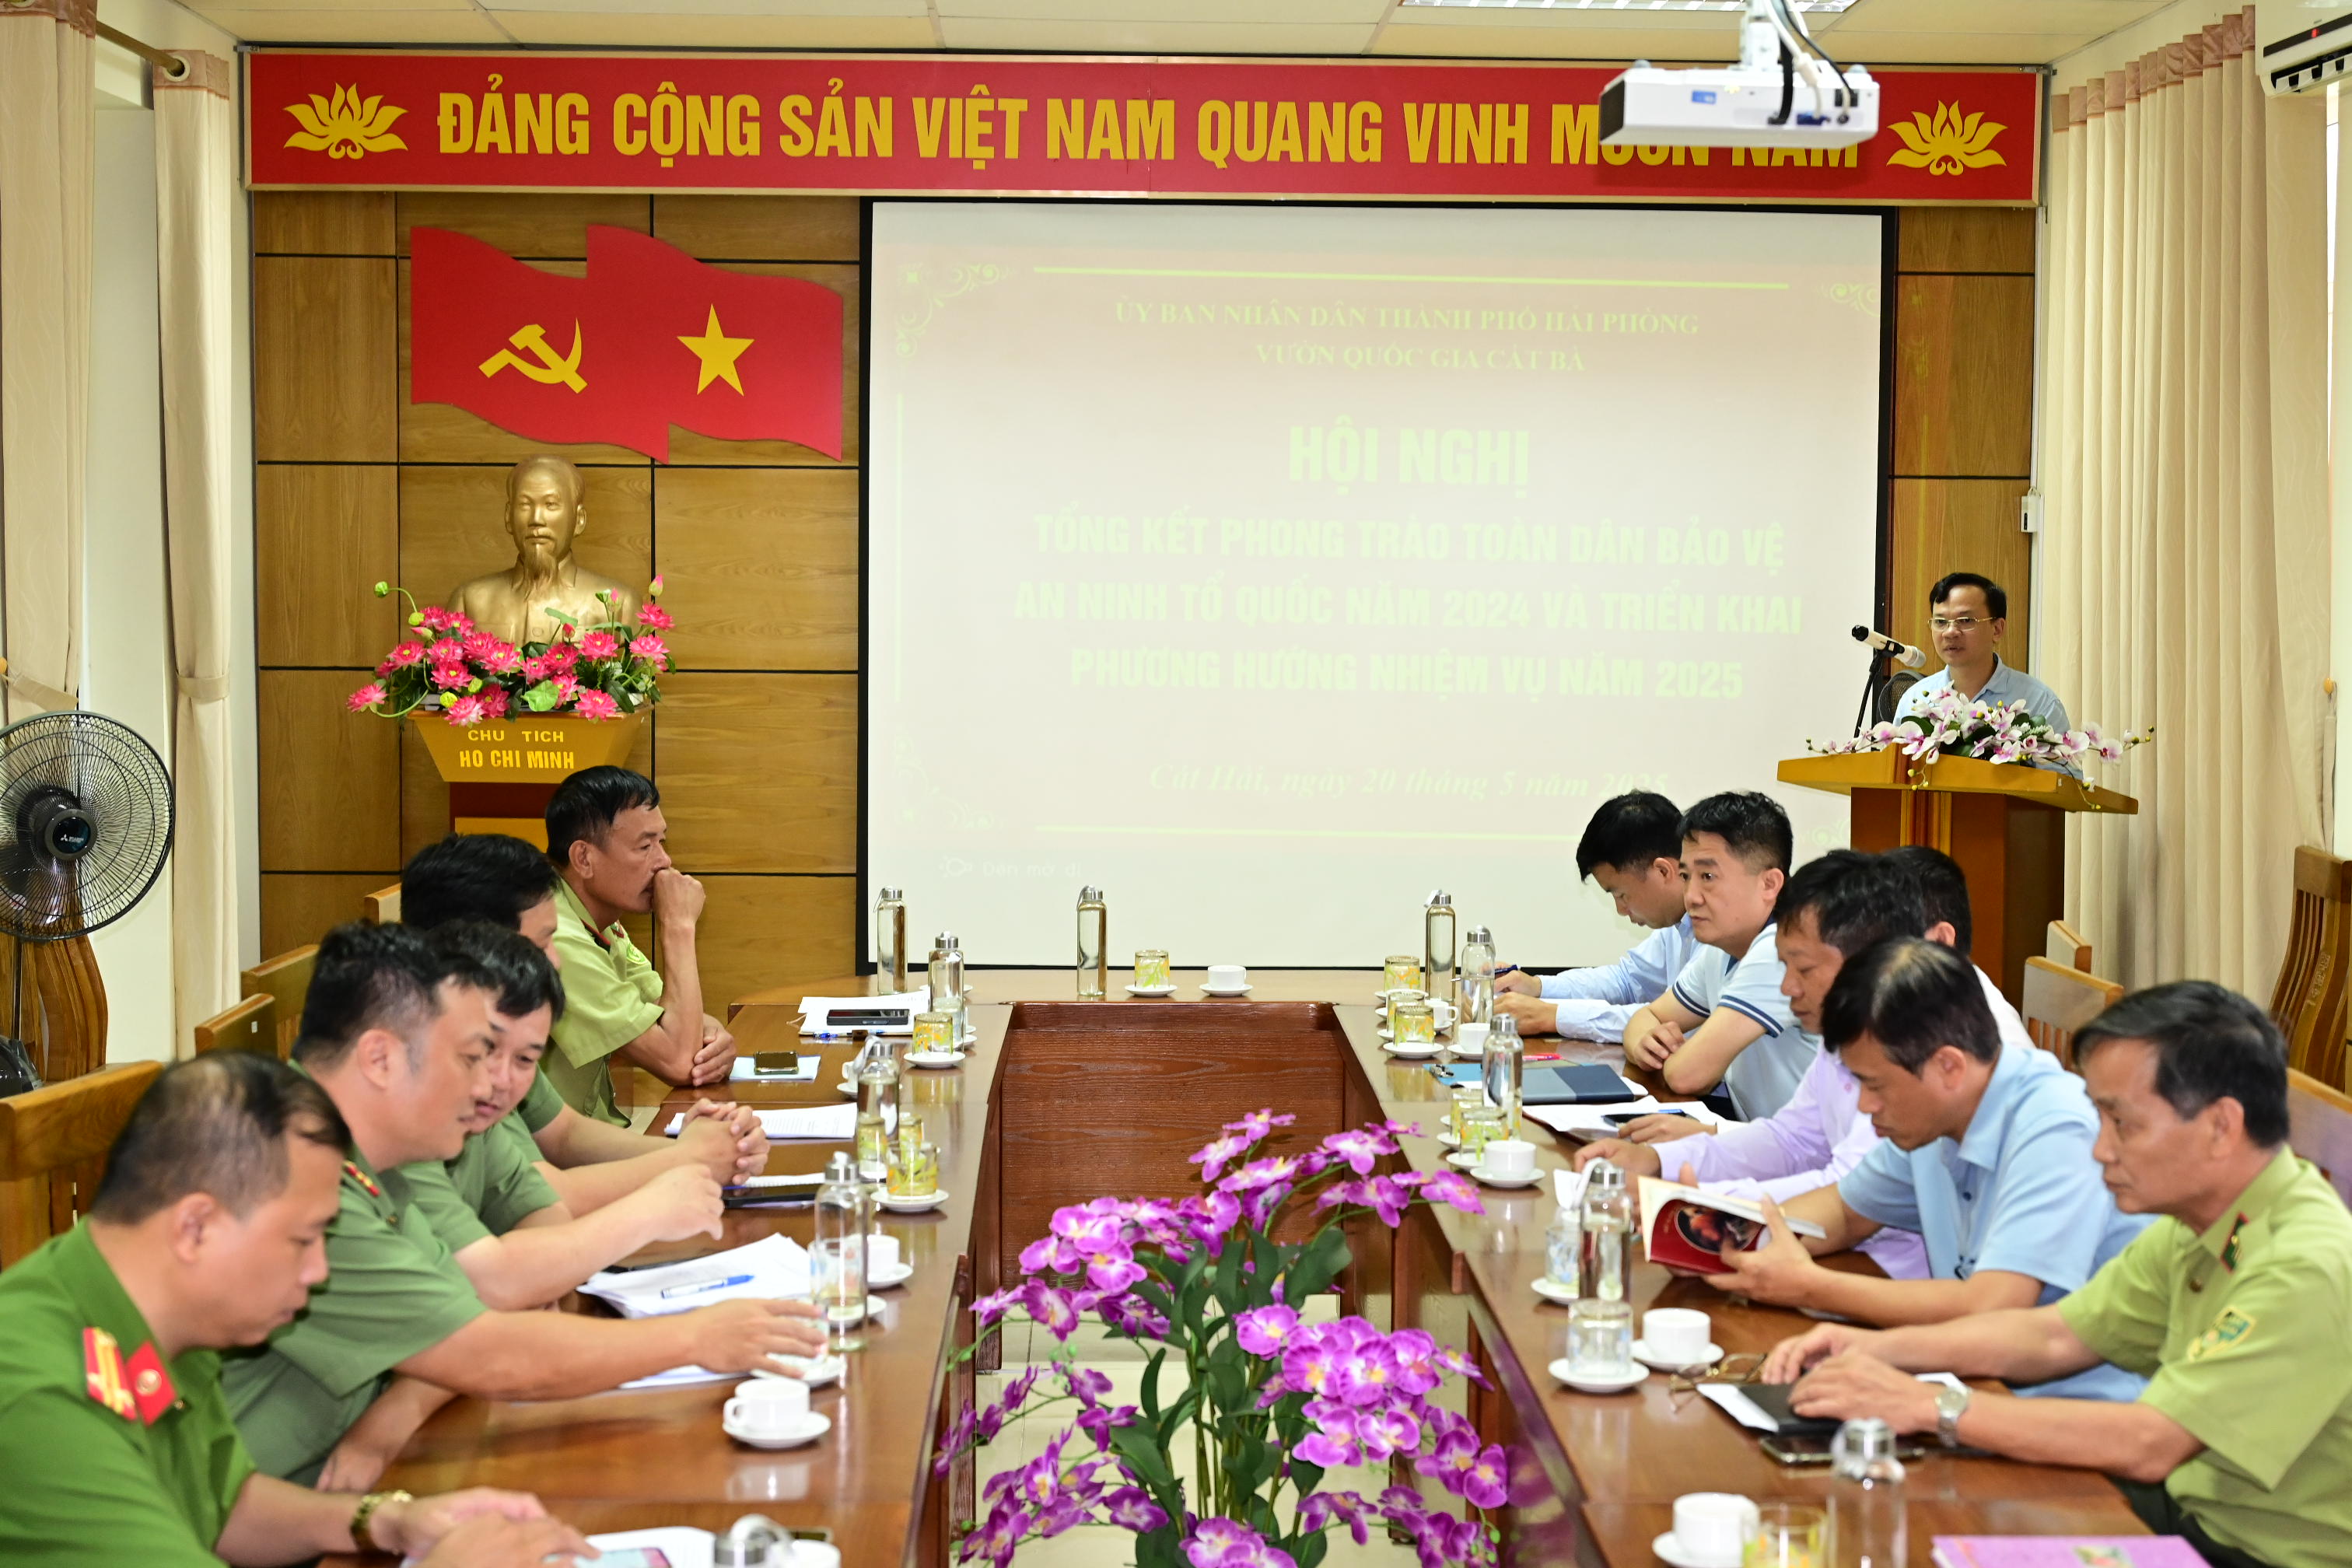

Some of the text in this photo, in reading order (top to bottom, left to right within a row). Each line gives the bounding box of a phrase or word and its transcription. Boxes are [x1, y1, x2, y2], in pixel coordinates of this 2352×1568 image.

[438, 73, 590, 155] ĐẢNG
[614, 81, 761, 168] CỘNG
[780, 79, 893, 158] SẢN
[913, 84, 1028, 170] VIỆT
[1048, 99, 1175, 160] NAM
[1199, 100, 1382, 169] QUANG
[1404, 103, 1529, 164] VINH
[1160, 303, 1216, 324] BAN
[1223, 298, 1301, 326] NHÂN
[1311, 299, 1367, 327] DÂN
[1377, 303, 1472, 331] THÀNH
[1480, 306, 1537, 331] PHỐ
[1545, 305, 1594, 333] HẢI
[1601, 306, 1699, 335] PHÒNG
[1342, 341, 1423, 370] QUỐC
[1430, 348, 1481, 369] GIA
[1486, 344, 1543, 371] CÁT
[1549, 346, 1585, 372] BÀ
[1288, 414, 1530, 499] HỘI NGHỊ
[1033, 501, 1786, 577] TỔNG KẾT PHONG TRÀO TOÀN DÂN BẢO VỆ
[1013, 569, 1804, 635] AN NINH TỔ QUỐC NĂM 2024 VÀ TRIỂN KHAI
[1070, 644, 1744, 703] PHƯƠNG HƯỚNG NHIỆM VỤ NĂM 2025
[460, 750, 575, 769] HO CHI MINH
[467, 730, 564, 743] CHU TICH
